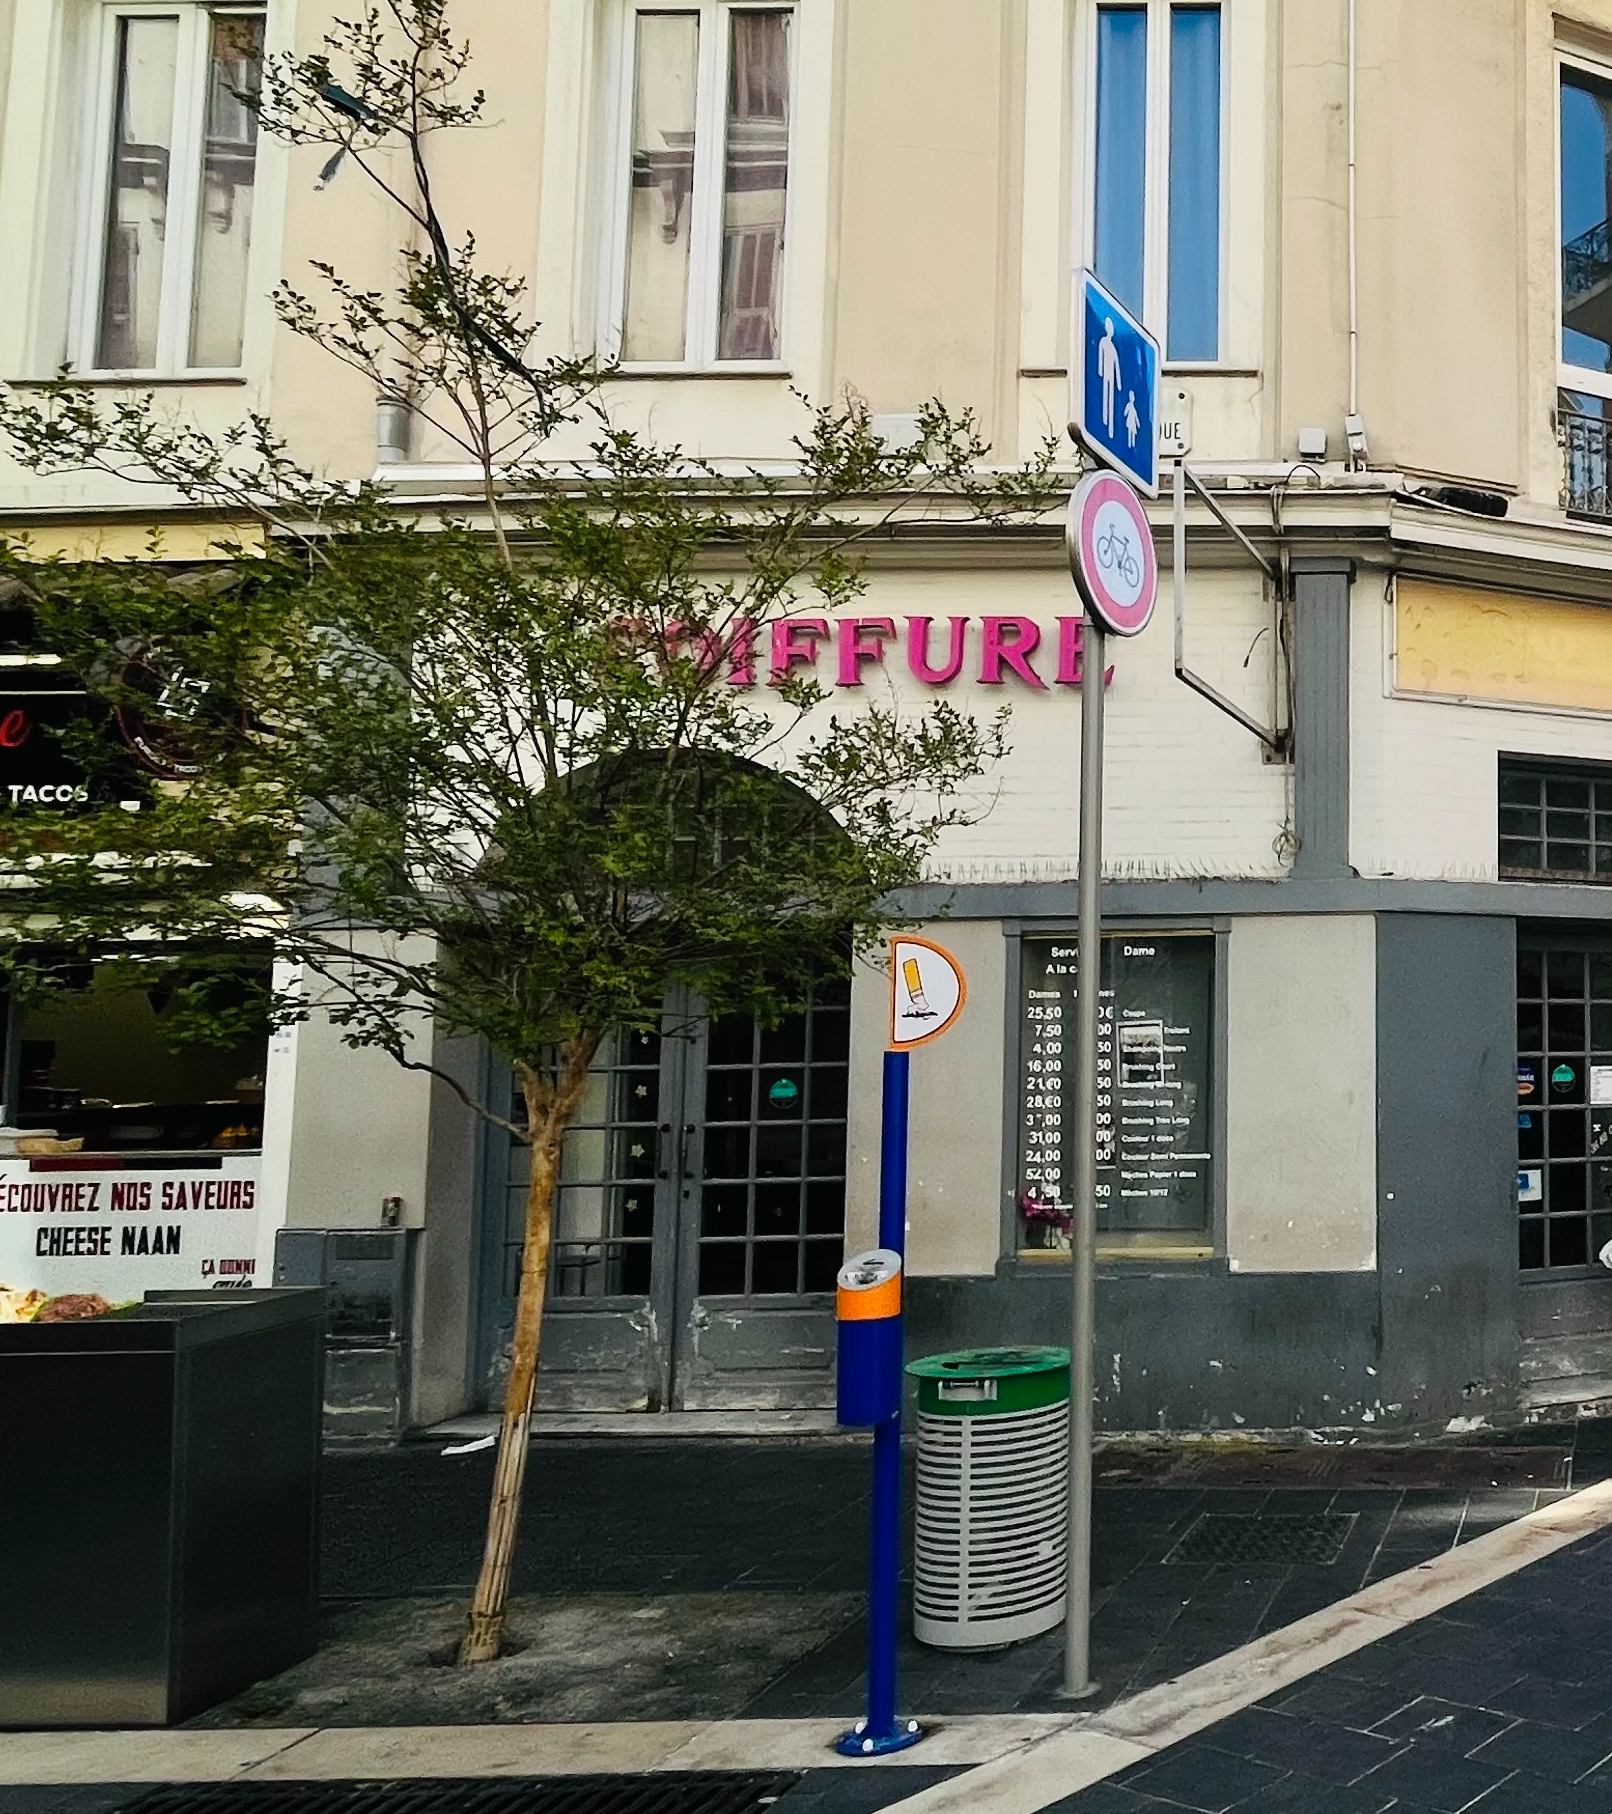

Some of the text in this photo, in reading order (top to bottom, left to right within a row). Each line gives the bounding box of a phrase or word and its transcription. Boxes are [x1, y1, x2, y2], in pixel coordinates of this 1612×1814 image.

[8, 784, 89, 803] TACOS
[1123, 945, 1156, 957] Dame
[1045, 963, 1056, 975] A
[1056, 963, 1067, 975] la
[0, 1173, 255, 1212] ÉCOUVREZ NOS SAVEURS
[36, 1225, 182, 1257] CHEESE NAAN
